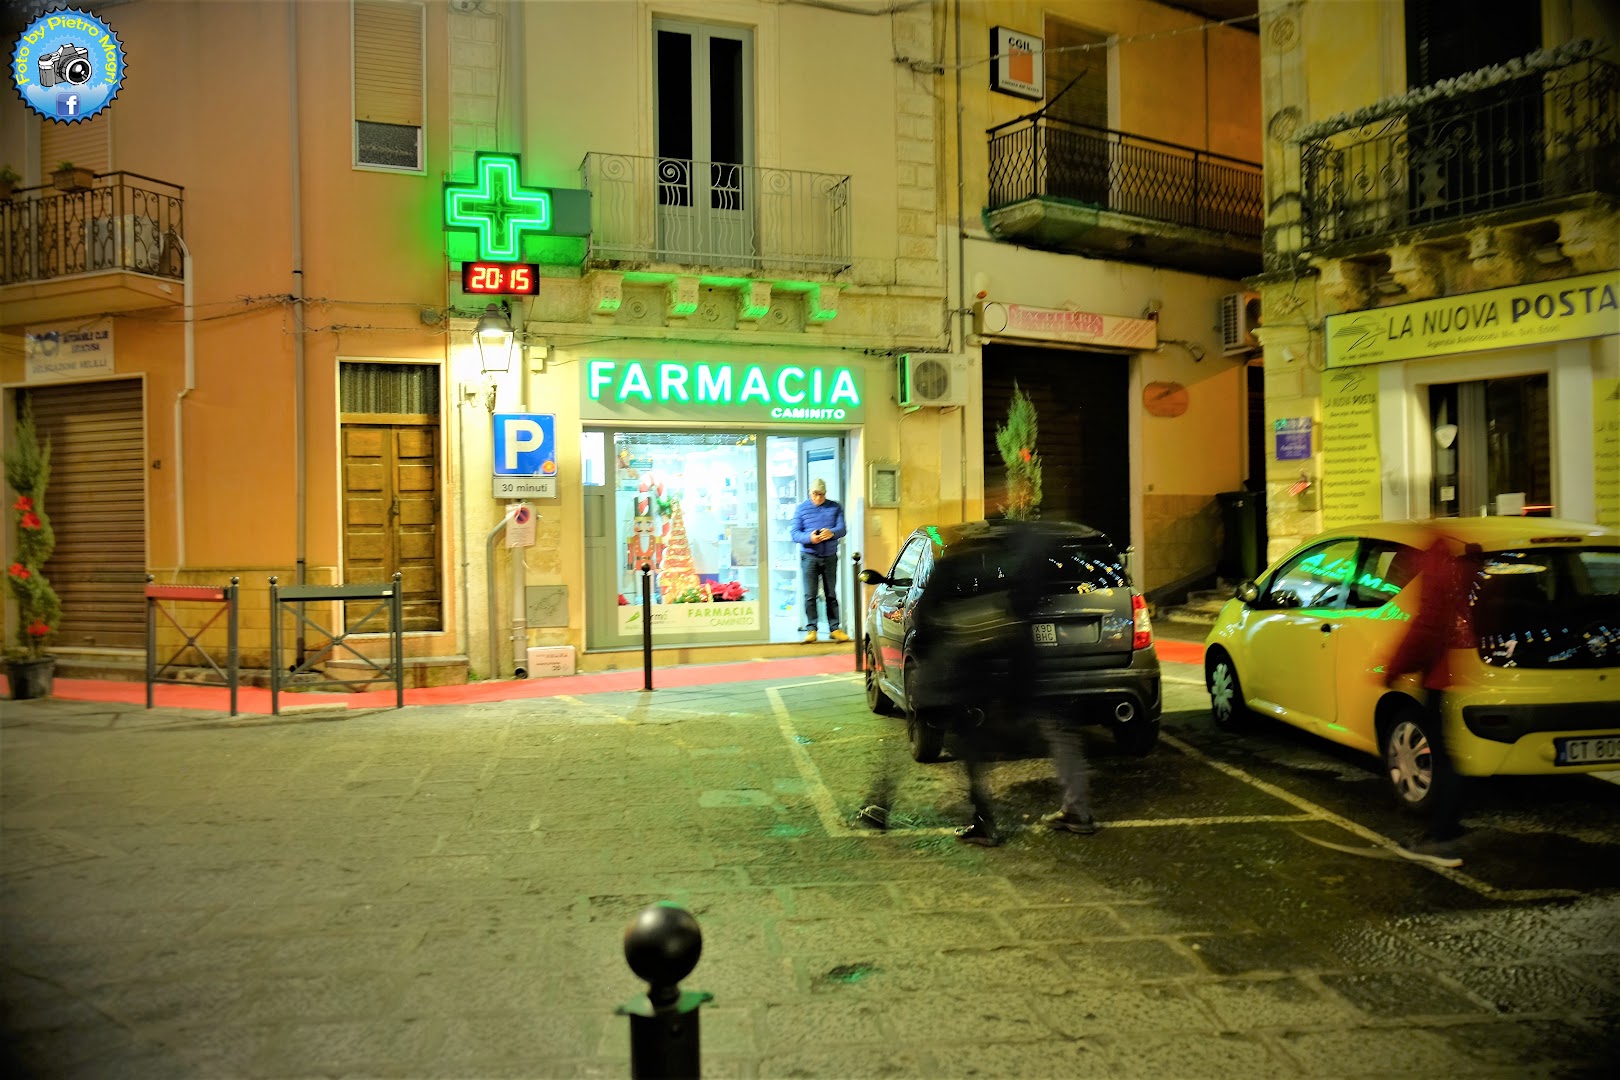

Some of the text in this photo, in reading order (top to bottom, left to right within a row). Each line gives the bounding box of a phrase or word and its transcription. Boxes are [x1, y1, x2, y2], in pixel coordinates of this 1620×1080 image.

[1008, 36, 1032, 53] CGIL
[1387, 283, 1620, 341] LA NUOVA POSTA
[588, 360, 861, 404] FARMACIA
[770, 406, 846, 420] CAMINITO
[504, 419, 544, 470] P
[502, 484, 548, 492] 30 minuti
[688, 606, 754, 618] FARMACIA
[710, 616, 754, 626] CAMINITO
[1569, 742, 1589, 760] CT
